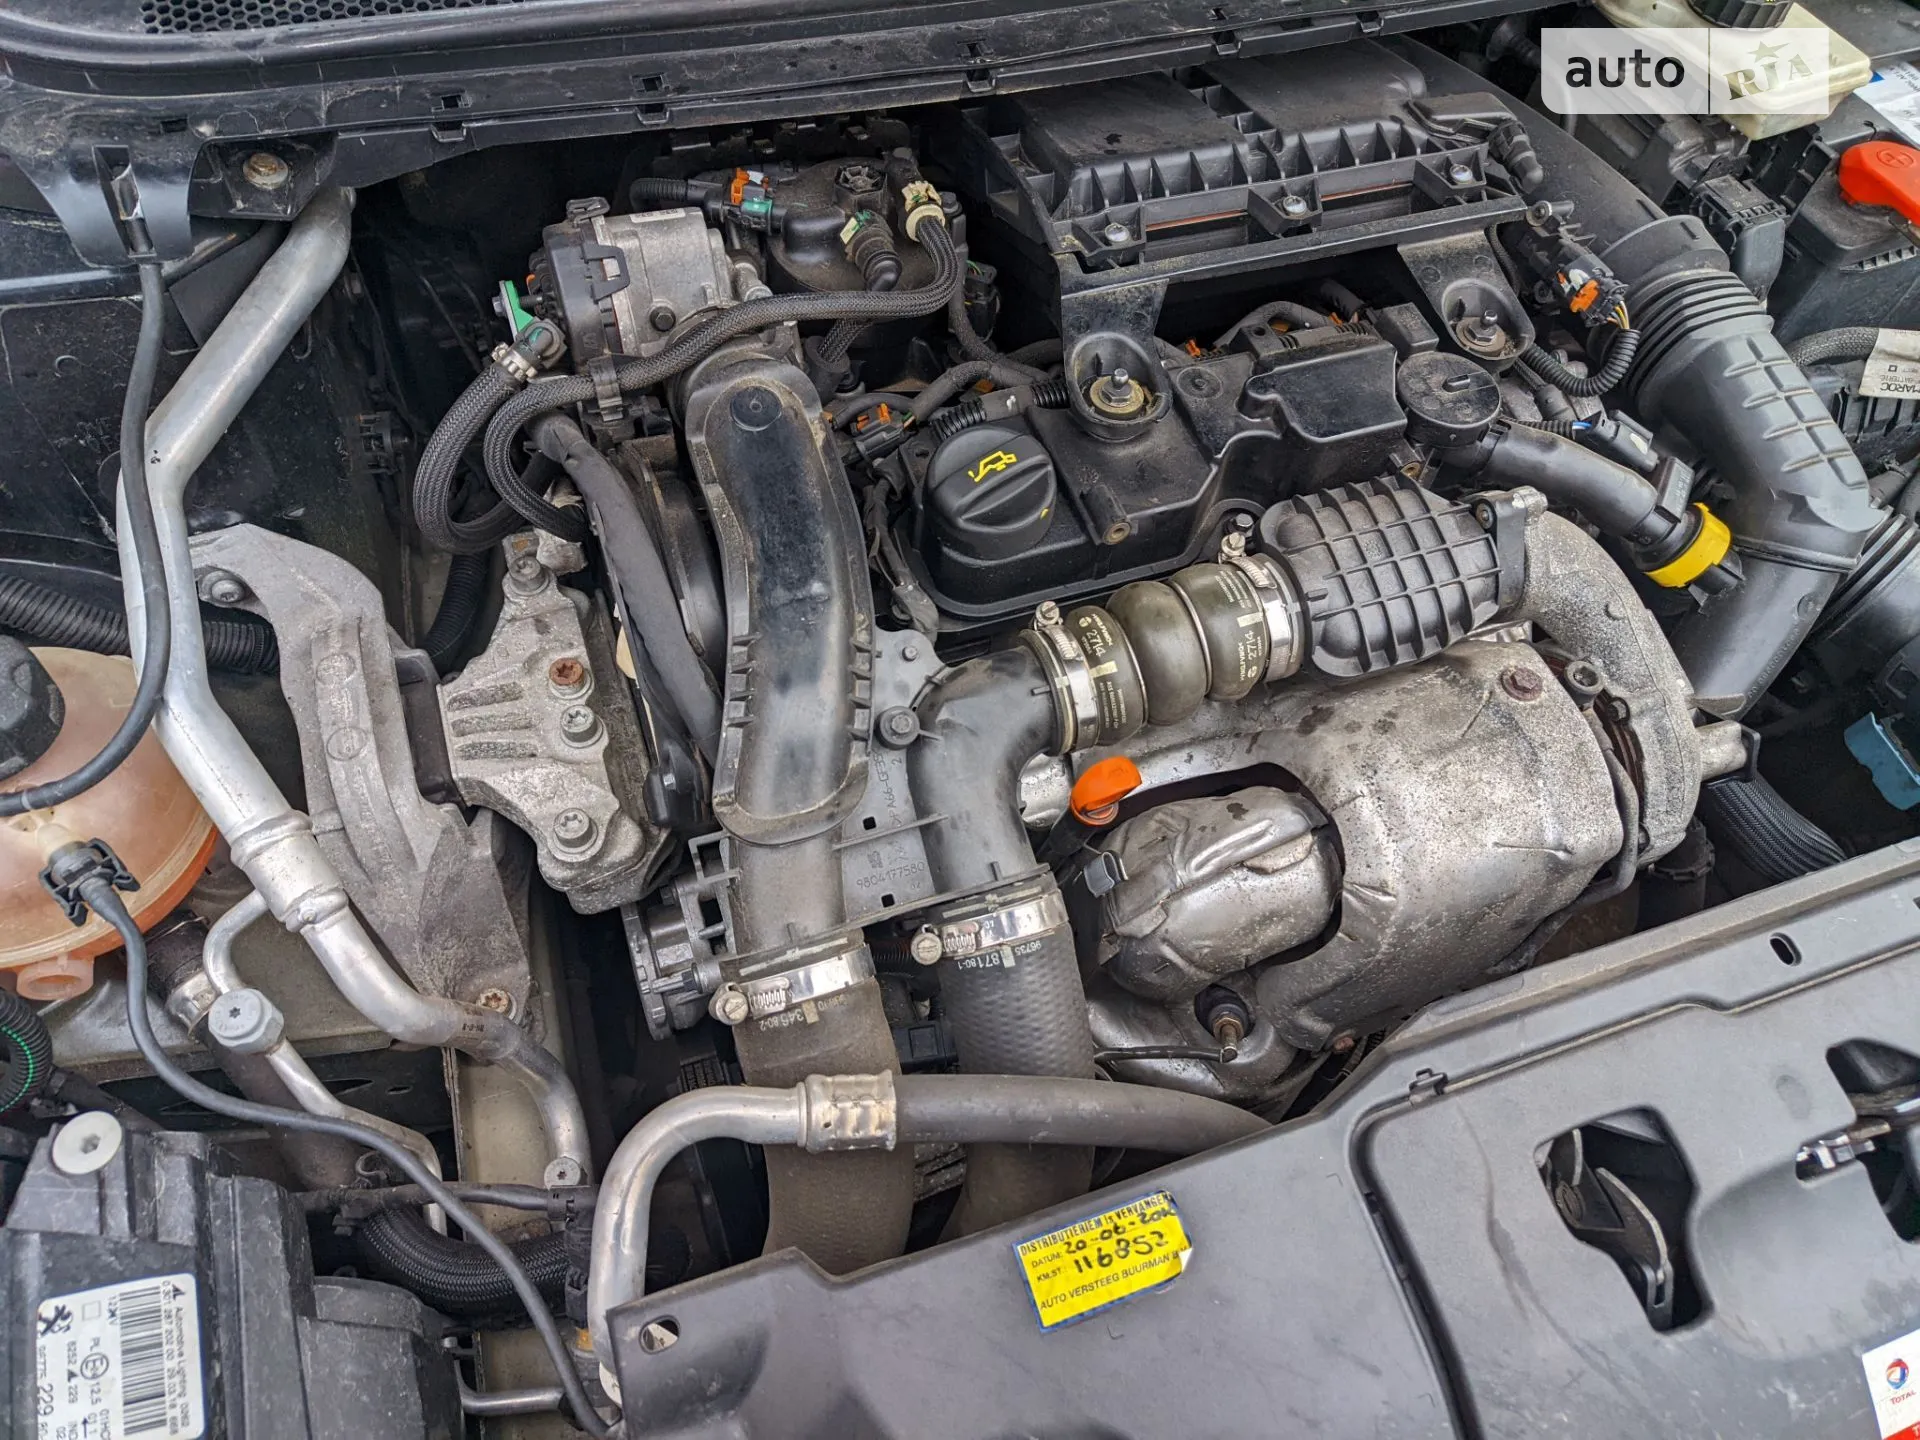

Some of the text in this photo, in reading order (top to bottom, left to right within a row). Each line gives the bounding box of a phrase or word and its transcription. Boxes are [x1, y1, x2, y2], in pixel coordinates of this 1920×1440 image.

[856, 861, 926, 889] 9804177580
[1040, 1292, 1067, 1311] AUTO
[1068, 1272, 1120, 1299] VERSTEEG
[1121, 1253, 1170, 1279] BUURMAN
[38, 1382, 55, 1417] 229
[1890, 1389, 1917, 1404] TOTAL
